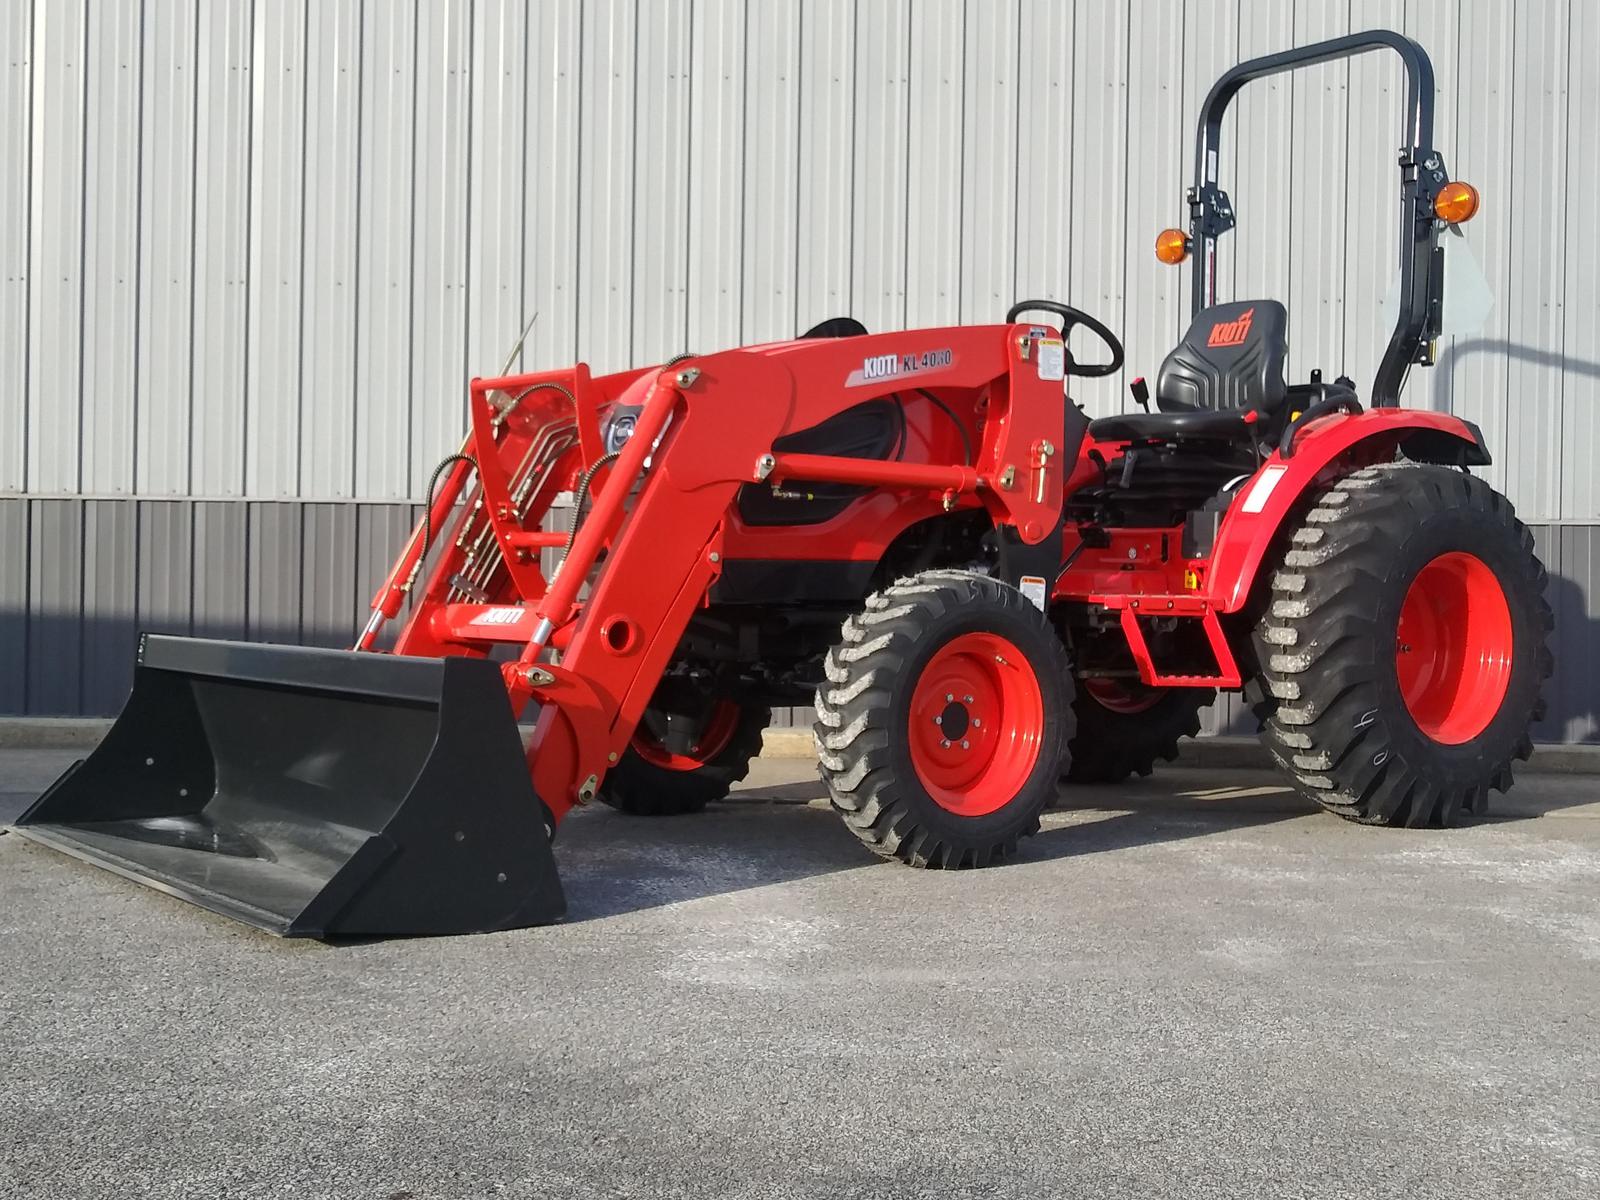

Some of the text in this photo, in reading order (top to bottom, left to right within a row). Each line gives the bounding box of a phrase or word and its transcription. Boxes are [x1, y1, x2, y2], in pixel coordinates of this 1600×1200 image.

[1208, 309, 1253, 346] KIOTI
[863, 354, 898, 379] KIOTI
[903, 355, 918, 372] KL
